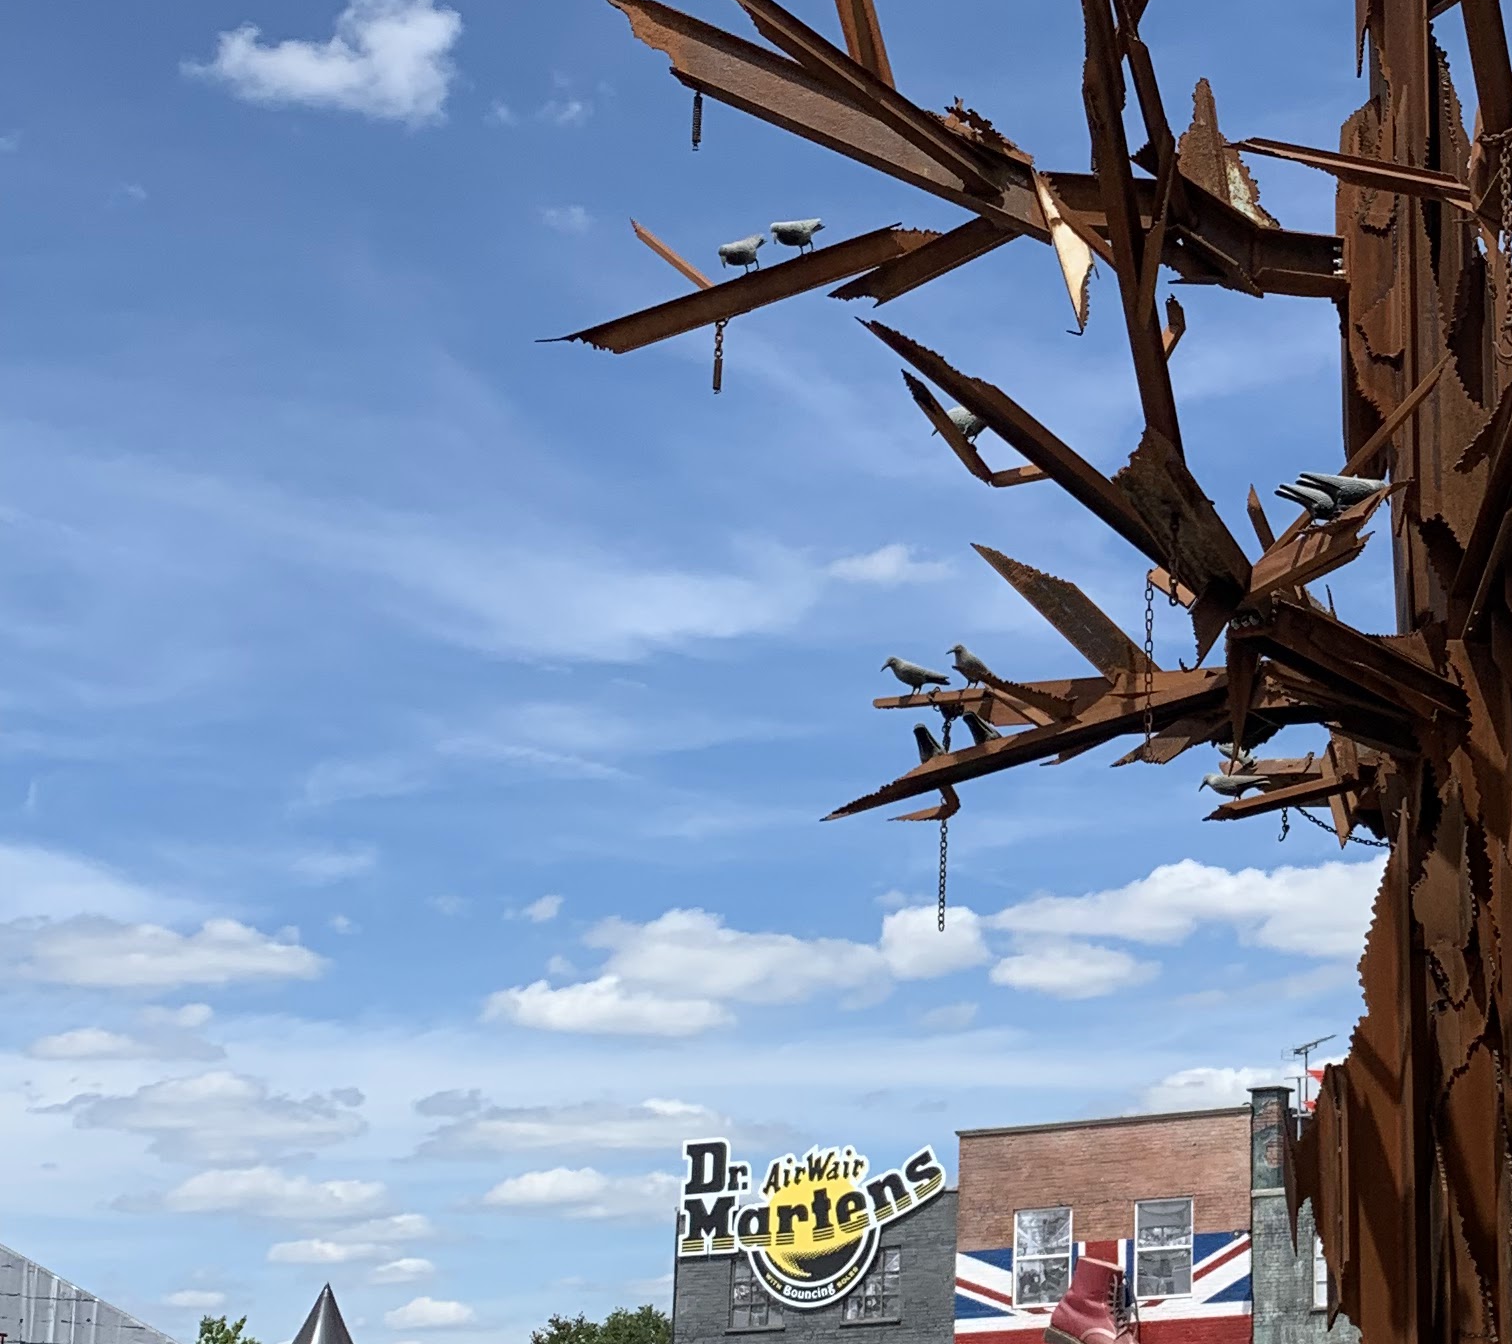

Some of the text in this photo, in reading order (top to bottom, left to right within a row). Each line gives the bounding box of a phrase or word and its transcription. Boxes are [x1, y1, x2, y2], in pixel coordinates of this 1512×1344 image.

[684, 1141, 748, 1195] Dr.
[762, 1149, 866, 1195] AirWair
[682, 1150, 943, 1253] Martens
[782, 1282, 836, 1300] Bouncing
